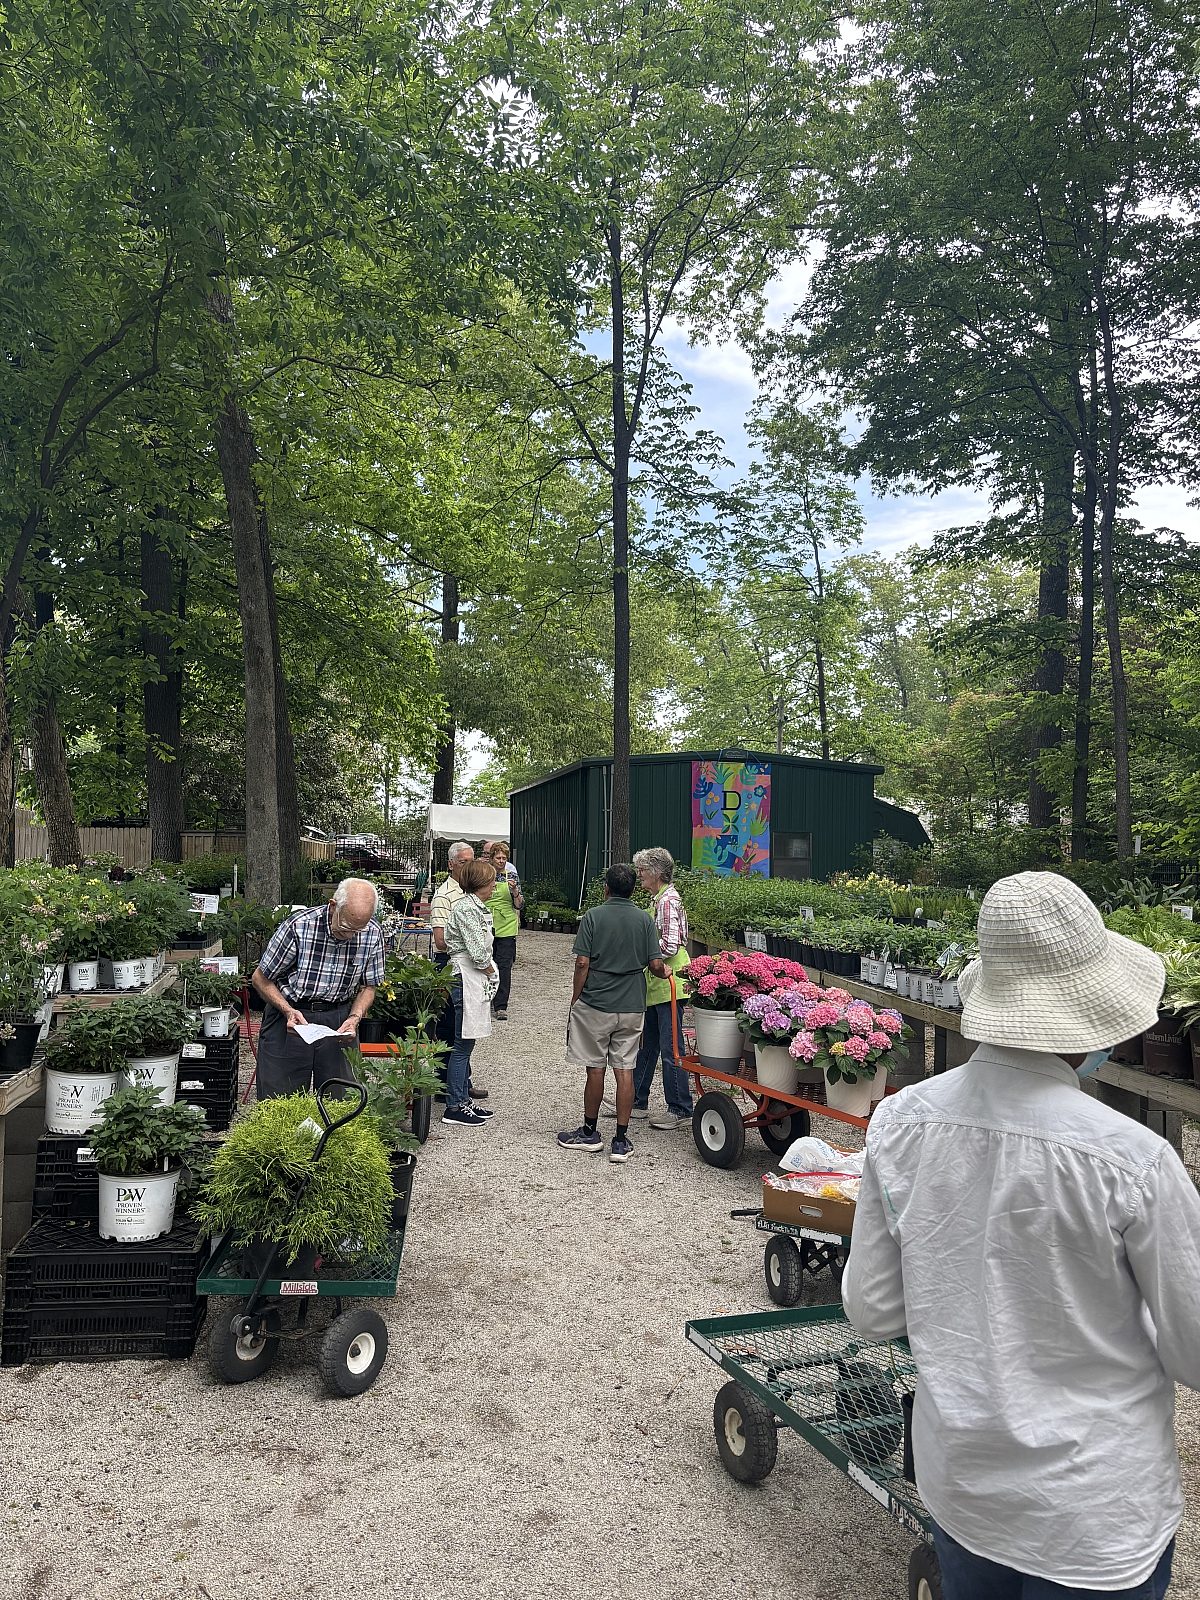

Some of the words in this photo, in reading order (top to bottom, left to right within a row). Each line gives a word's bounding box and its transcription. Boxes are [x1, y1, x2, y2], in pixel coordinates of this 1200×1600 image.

[721, 790, 742, 811] D
[116, 1188, 147, 1202] PW
[283, 1282, 316, 1290] Millside
